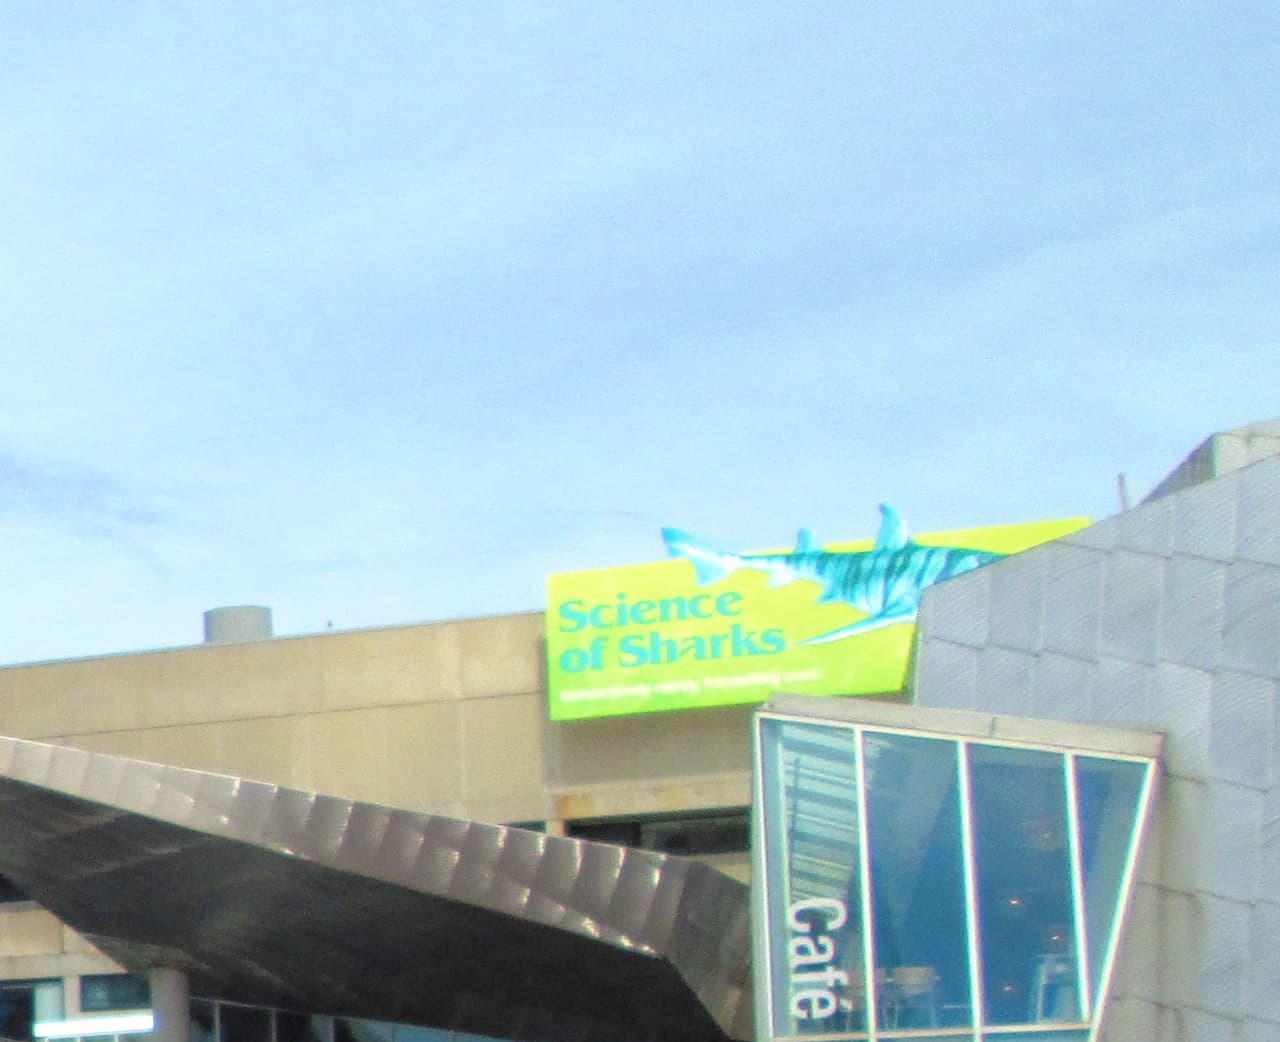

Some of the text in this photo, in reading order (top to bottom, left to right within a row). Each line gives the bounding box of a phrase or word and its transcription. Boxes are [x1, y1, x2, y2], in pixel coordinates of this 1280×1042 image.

[557, 591, 744, 633] Science
[559, 623, 786, 673] of Sharks
[789, 900, 853, 1020] Café
